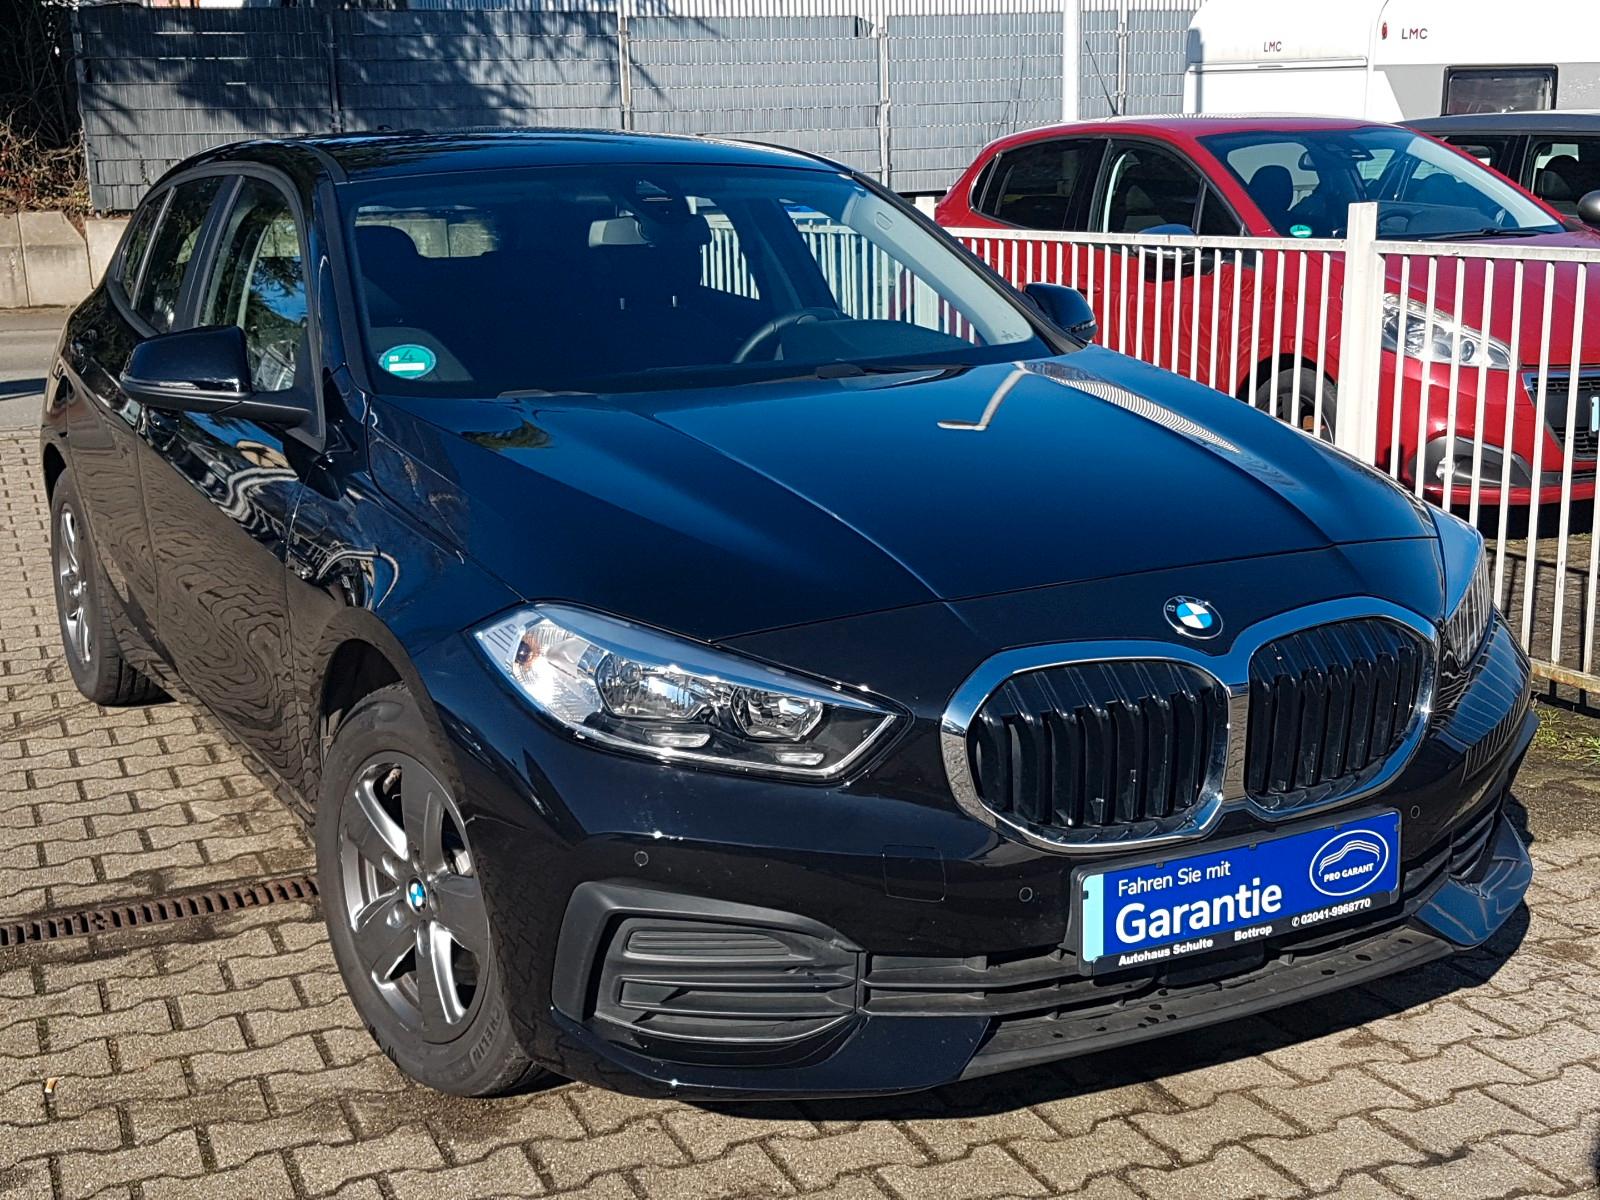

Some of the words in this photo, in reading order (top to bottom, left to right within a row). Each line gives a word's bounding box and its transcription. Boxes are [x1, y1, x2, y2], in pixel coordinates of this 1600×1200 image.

[1401, 28, 1428, 40] LMC
[1263, 41, 1282, 53] LMC
[401, 350, 415, 362] 4
[1118, 874, 1173, 897] Fahren
[1177, 867, 1201, 886] Sie
[1206, 861, 1231, 880] mit
[1323, 871, 1341, 883] PRO
[1341, 862, 1374, 878] GARANT
[1115, 877, 1283, 944] Garantie
[1118, 947, 1171, 967] Autohaus
[1172, 938, 1215, 955] Schulte
[1234, 924, 1273, 942] Bottrop
[1300, 897, 1371, 925] 02041-9968770
